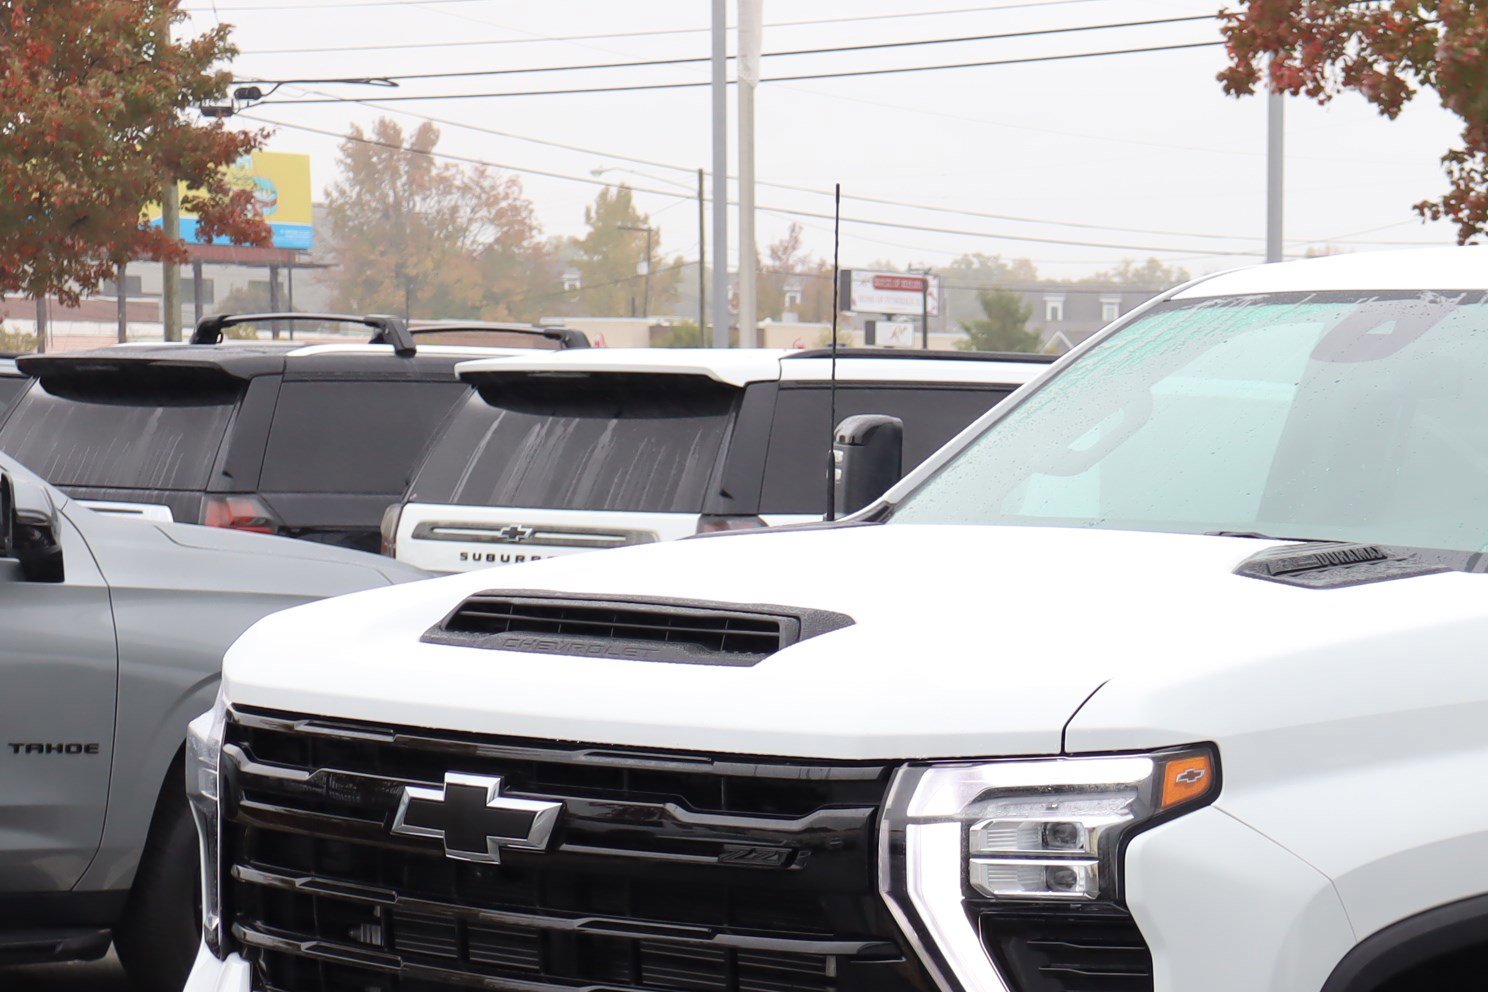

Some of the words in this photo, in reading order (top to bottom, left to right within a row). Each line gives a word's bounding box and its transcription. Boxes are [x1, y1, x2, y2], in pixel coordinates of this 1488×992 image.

[460, 552, 557, 564] SUBUR
[502, 638, 659, 657] CHEVROLET
[8, 742, 100, 755] TAHOE
